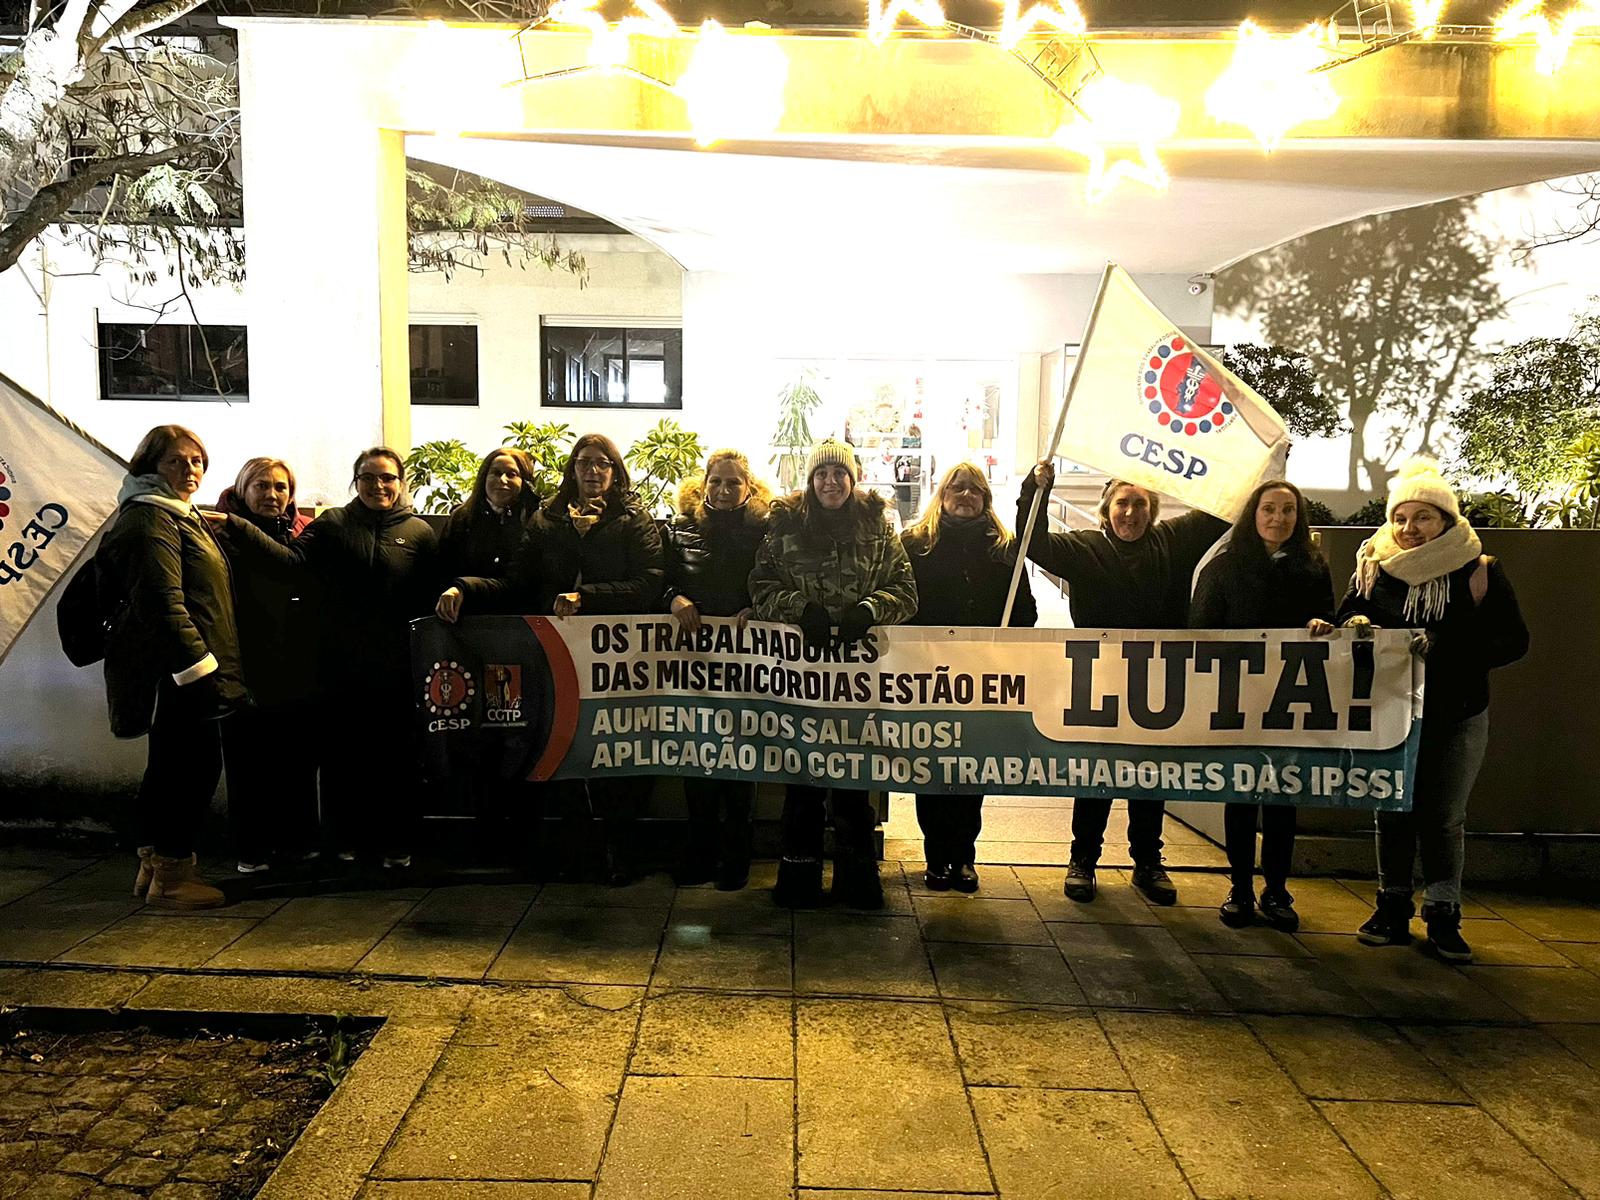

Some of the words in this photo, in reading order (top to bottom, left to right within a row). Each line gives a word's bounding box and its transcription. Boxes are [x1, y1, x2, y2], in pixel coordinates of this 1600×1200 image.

[1119, 433, 1208, 480] CESP
[591, 623, 629, 654] OS
[591, 660, 649, 692] DAS
[656, 659, 872, 703] MISERICÓRDIAS
[879, 665, 974, 705] ESTÃO
[981, 674, 1026, 705] EM
[1063, 639, 1375, 732] LUTA!
[428, 718, 472, 733] CESP
[487, 709, 522, 722] CGTP
[591, 706, 734, 736] AUMENTO
[740, 709, 796, 740] DOS
[800, 712, 963, 750] SALÁRIOS!
[591, 735, 757, 776] APLICAÇÃO
[763, 745, 802, 774] DO
[807, 751, 865, 780] CCT
[871, 754, 932, 785] DOS
[937, 755, 1226, 792] TRABALHADORES
[1232, 762, 1303, 796] DAS
[1311, 765, 1405, 800] IPSS!
